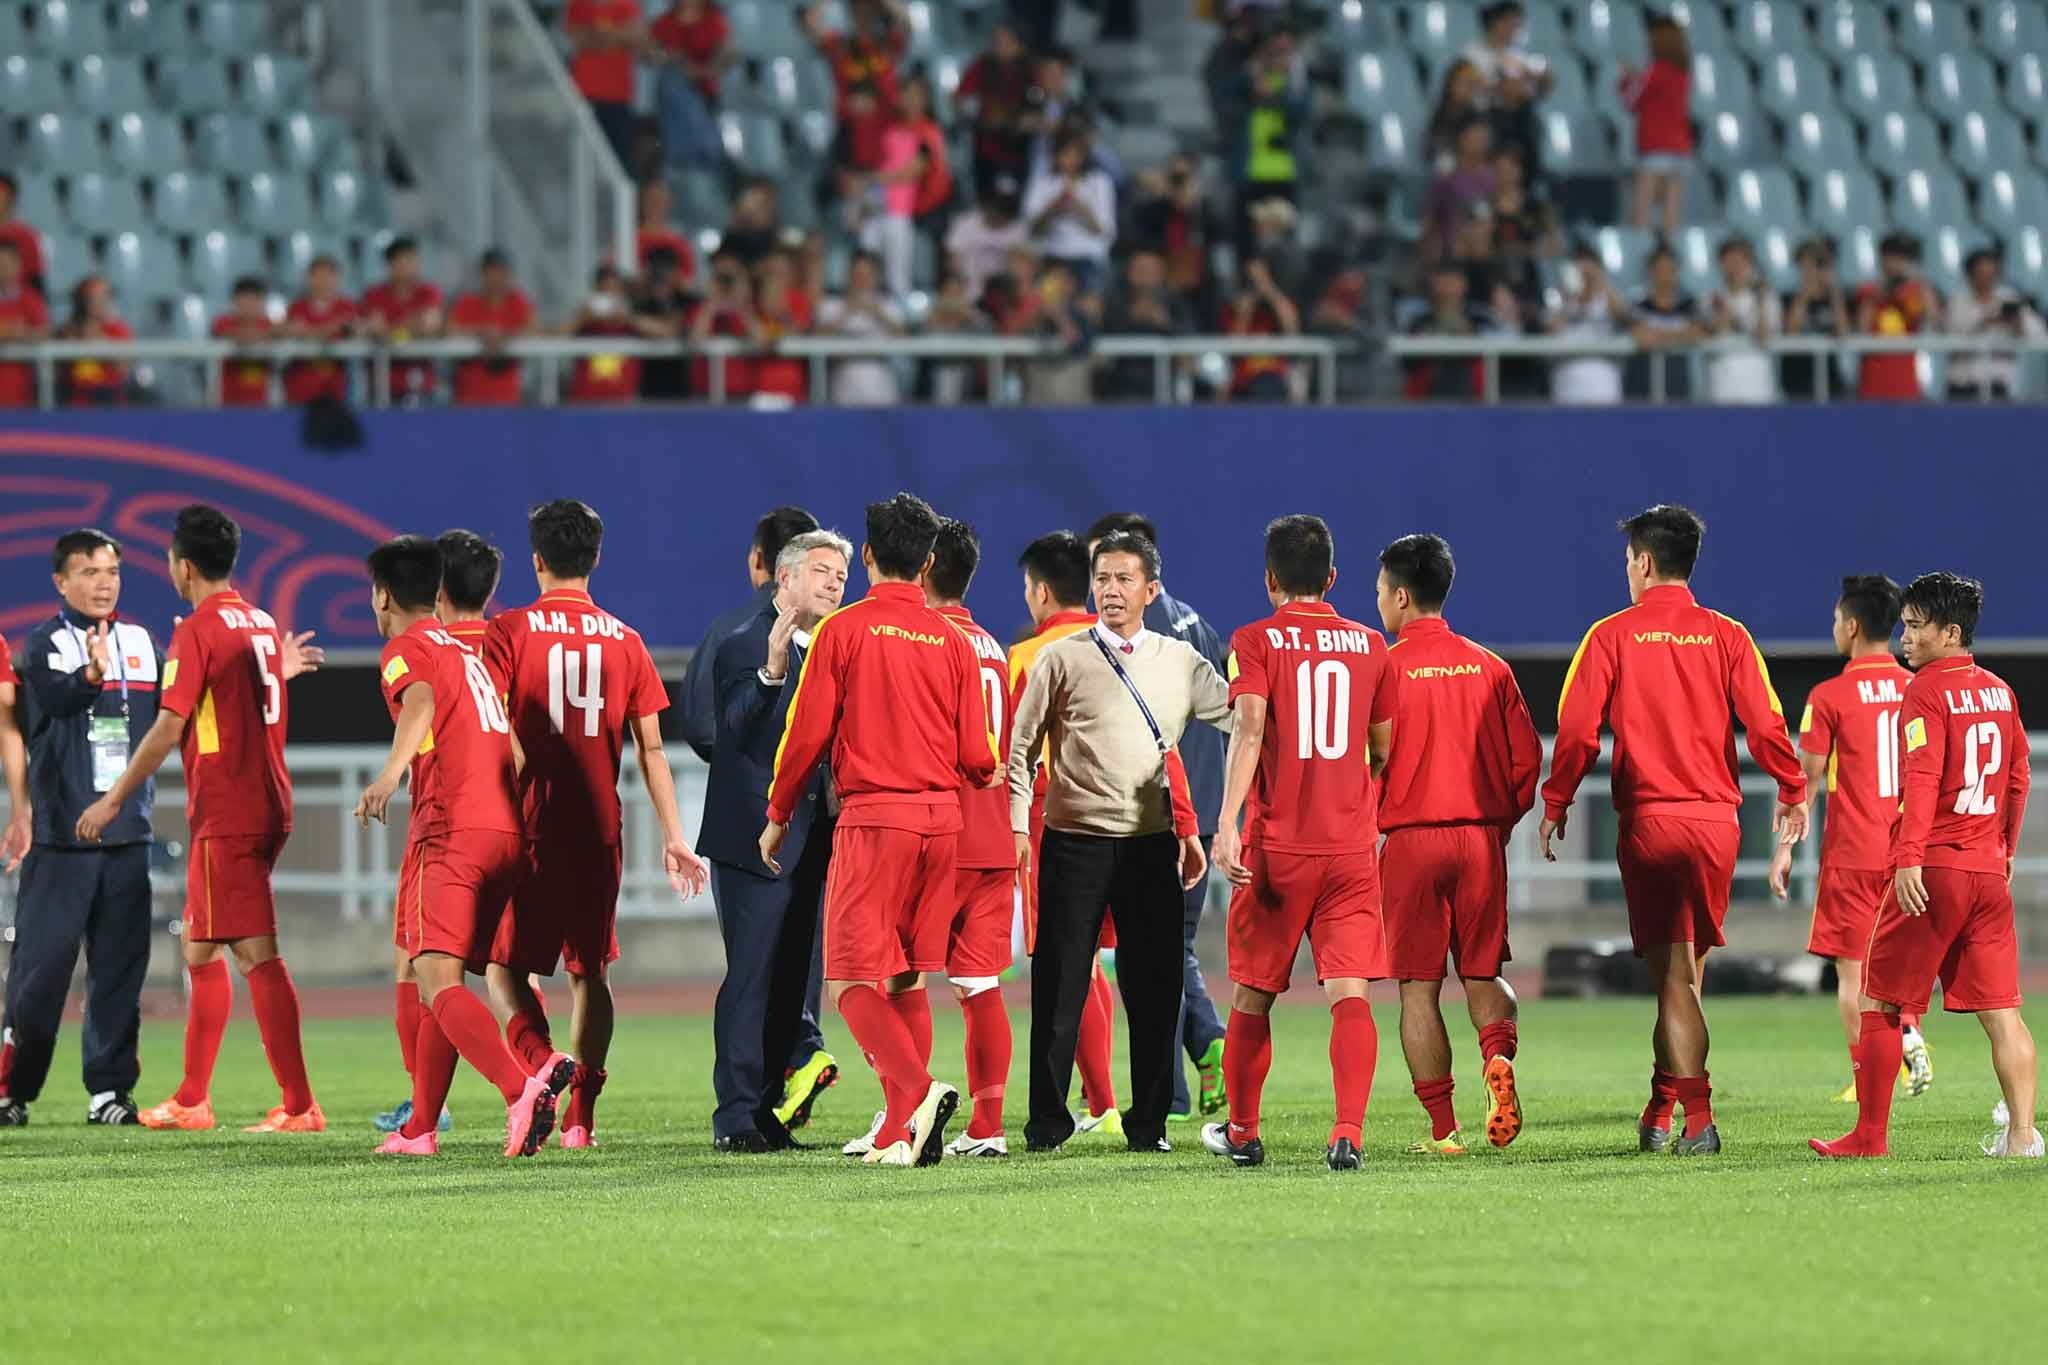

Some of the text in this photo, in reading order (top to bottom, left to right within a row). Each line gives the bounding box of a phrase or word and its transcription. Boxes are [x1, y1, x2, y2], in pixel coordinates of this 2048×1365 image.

[527, 609, 625, 640] N.H. DUC
[869, 624, 945, 647] VIETNAM
[1633, 631, 1713, 646] VIETNAM
[1265, 626, 1370, 656] D.T. BINH
[251, 634, 281, 725] 5
[1407, 664, 1482, 680] VIETNAM
[548, 641, 605, 737] 14
[1856, 679, 1904, 704] H.M.
[1944, 687, 2012, 715] L.H. NAM
[1296, 659, 1350, 760] 10
[1953, 720, 2002, 816] 12
